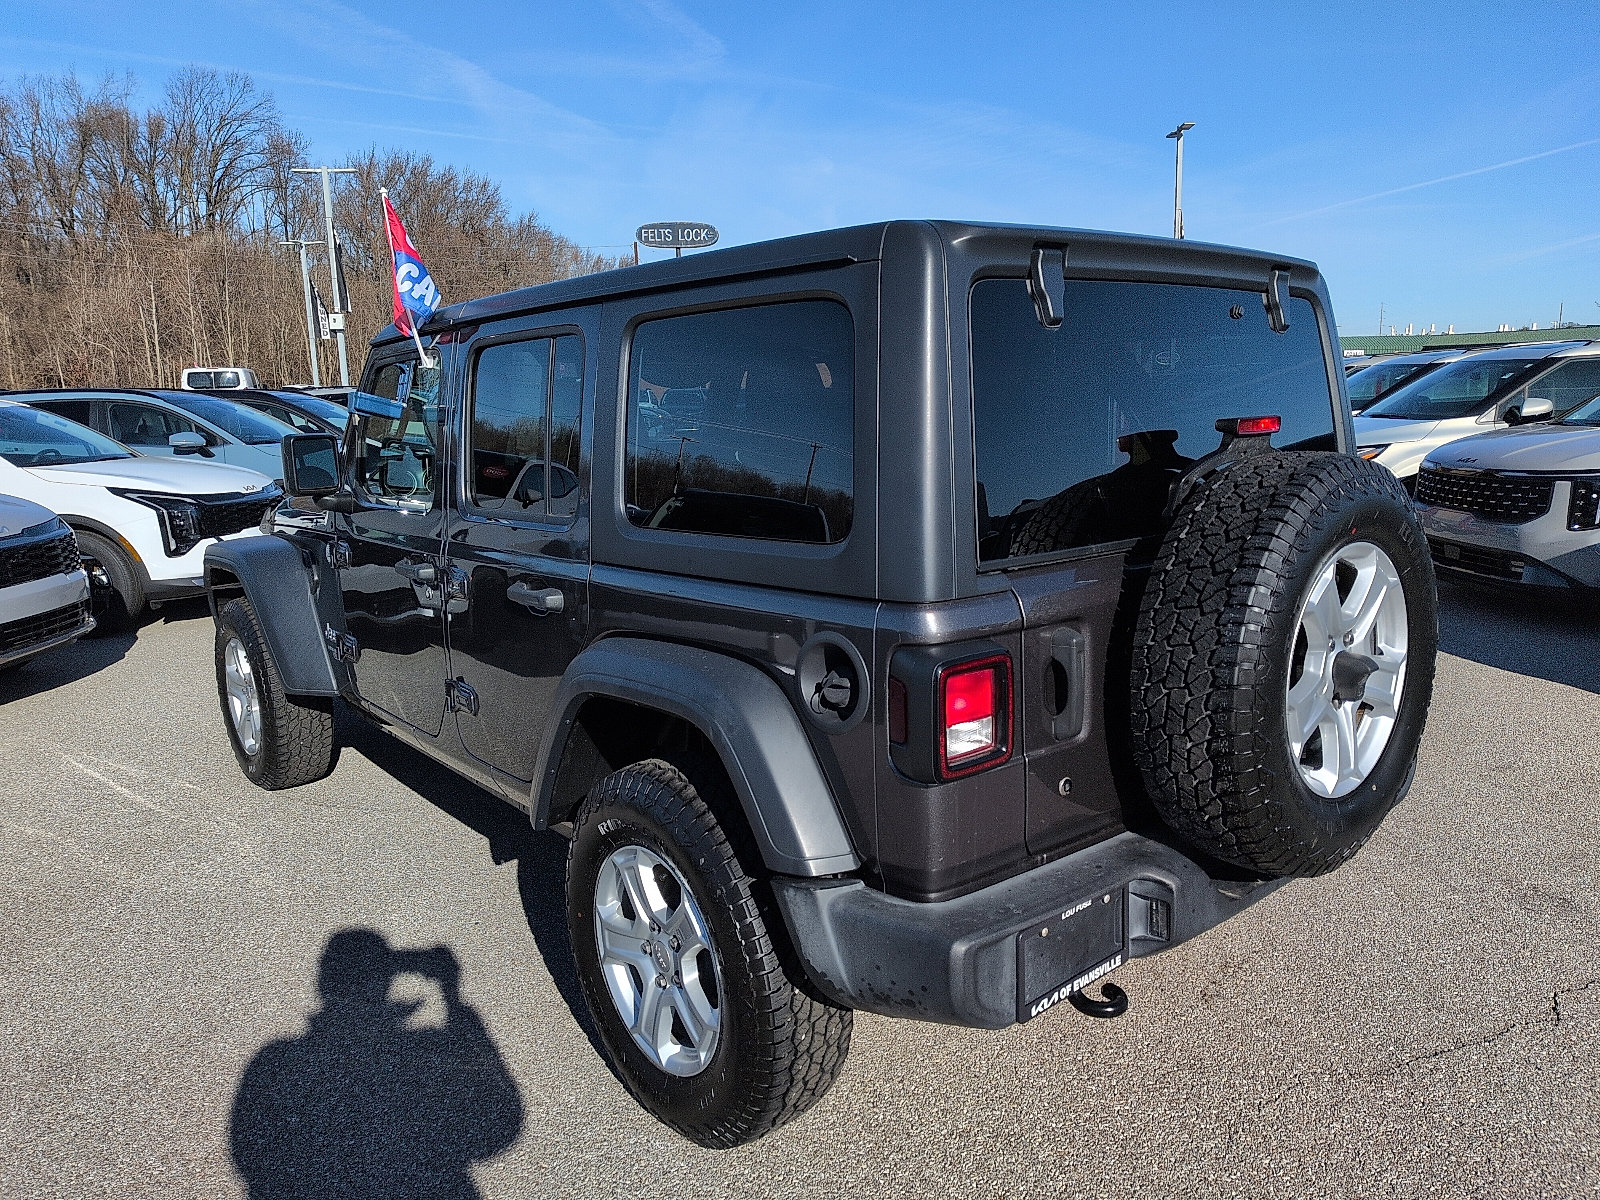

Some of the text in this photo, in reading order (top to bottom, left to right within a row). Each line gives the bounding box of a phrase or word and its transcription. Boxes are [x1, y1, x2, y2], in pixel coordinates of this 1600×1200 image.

[641, 228, 673, 242] FELTS
[678, 228, 709, 242] LOCK
[396, 262, 442, 312] CA
[1061, 906, 1076, 921] LOU
[1030, 954, 1122, 1018] KIA OF EVANSVILLE
